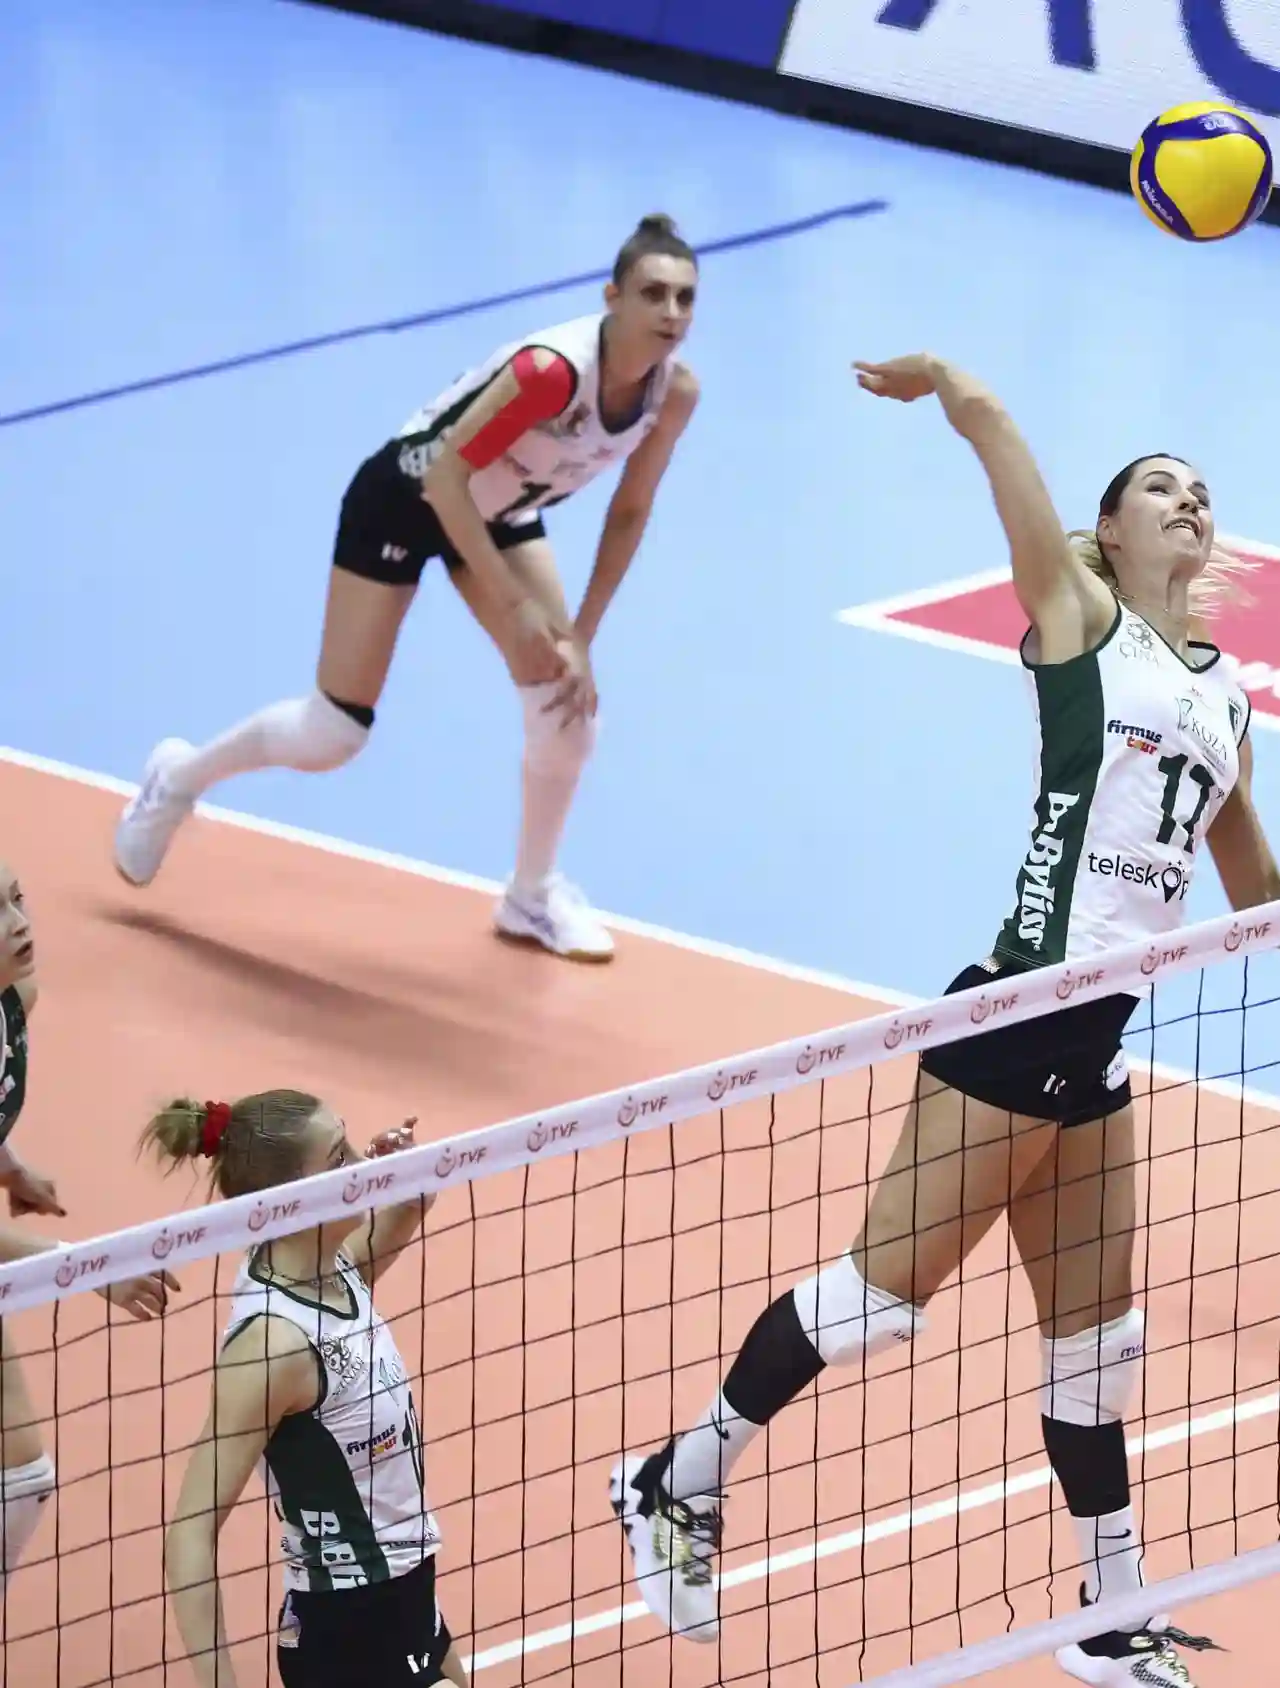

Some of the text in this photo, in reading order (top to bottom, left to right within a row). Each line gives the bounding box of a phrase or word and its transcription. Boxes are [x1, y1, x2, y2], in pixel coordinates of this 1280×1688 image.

[1107, 719, 1163, 744] firmus
[1243, 922, 1273, 943] TVF
[1159, 946, 1189, 966] TVF
[1075, 970, 1104, 990] TVF
[990, 994, 1019, 1015] TVF
[904, 1019, 933, 1041] TVF
[818, 1044, 846, 1065] TVF
[729, 1070, 758, 1090] TVF
[639, 1096, 669, 1118] TVF
[550, 1121, 579, 1141] TVF
[458, 1147, 488, 1168] TVF
[364, 1173, 396, 1195] TVF
[271, 1200, 300, 1221] TVF
[176, 1227, 207, 1249] TVF
[79, 1255, 109, 1275] TVF
[346, 1423, 396, 1456] firmus
